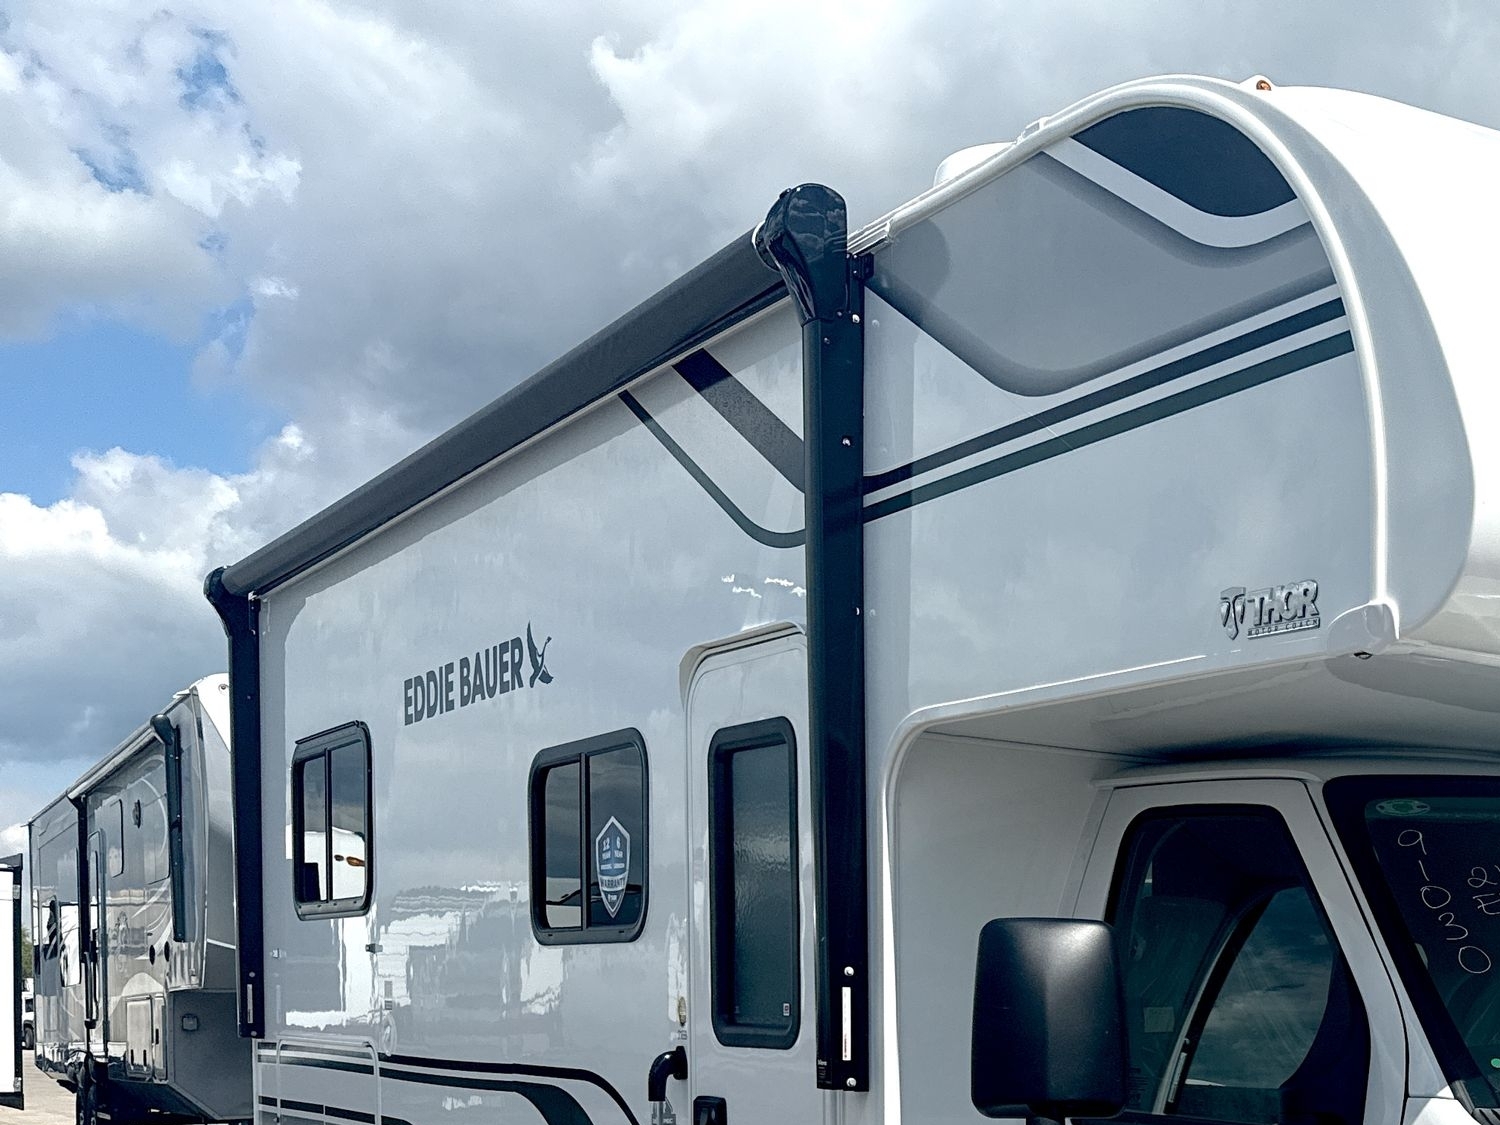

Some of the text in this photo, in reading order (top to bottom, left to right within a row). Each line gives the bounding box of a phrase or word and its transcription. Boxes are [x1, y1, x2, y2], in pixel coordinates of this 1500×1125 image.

[1247, 580, 1320, 627] THOR
[404, 637, 524, 726] EDDIE BAUER
